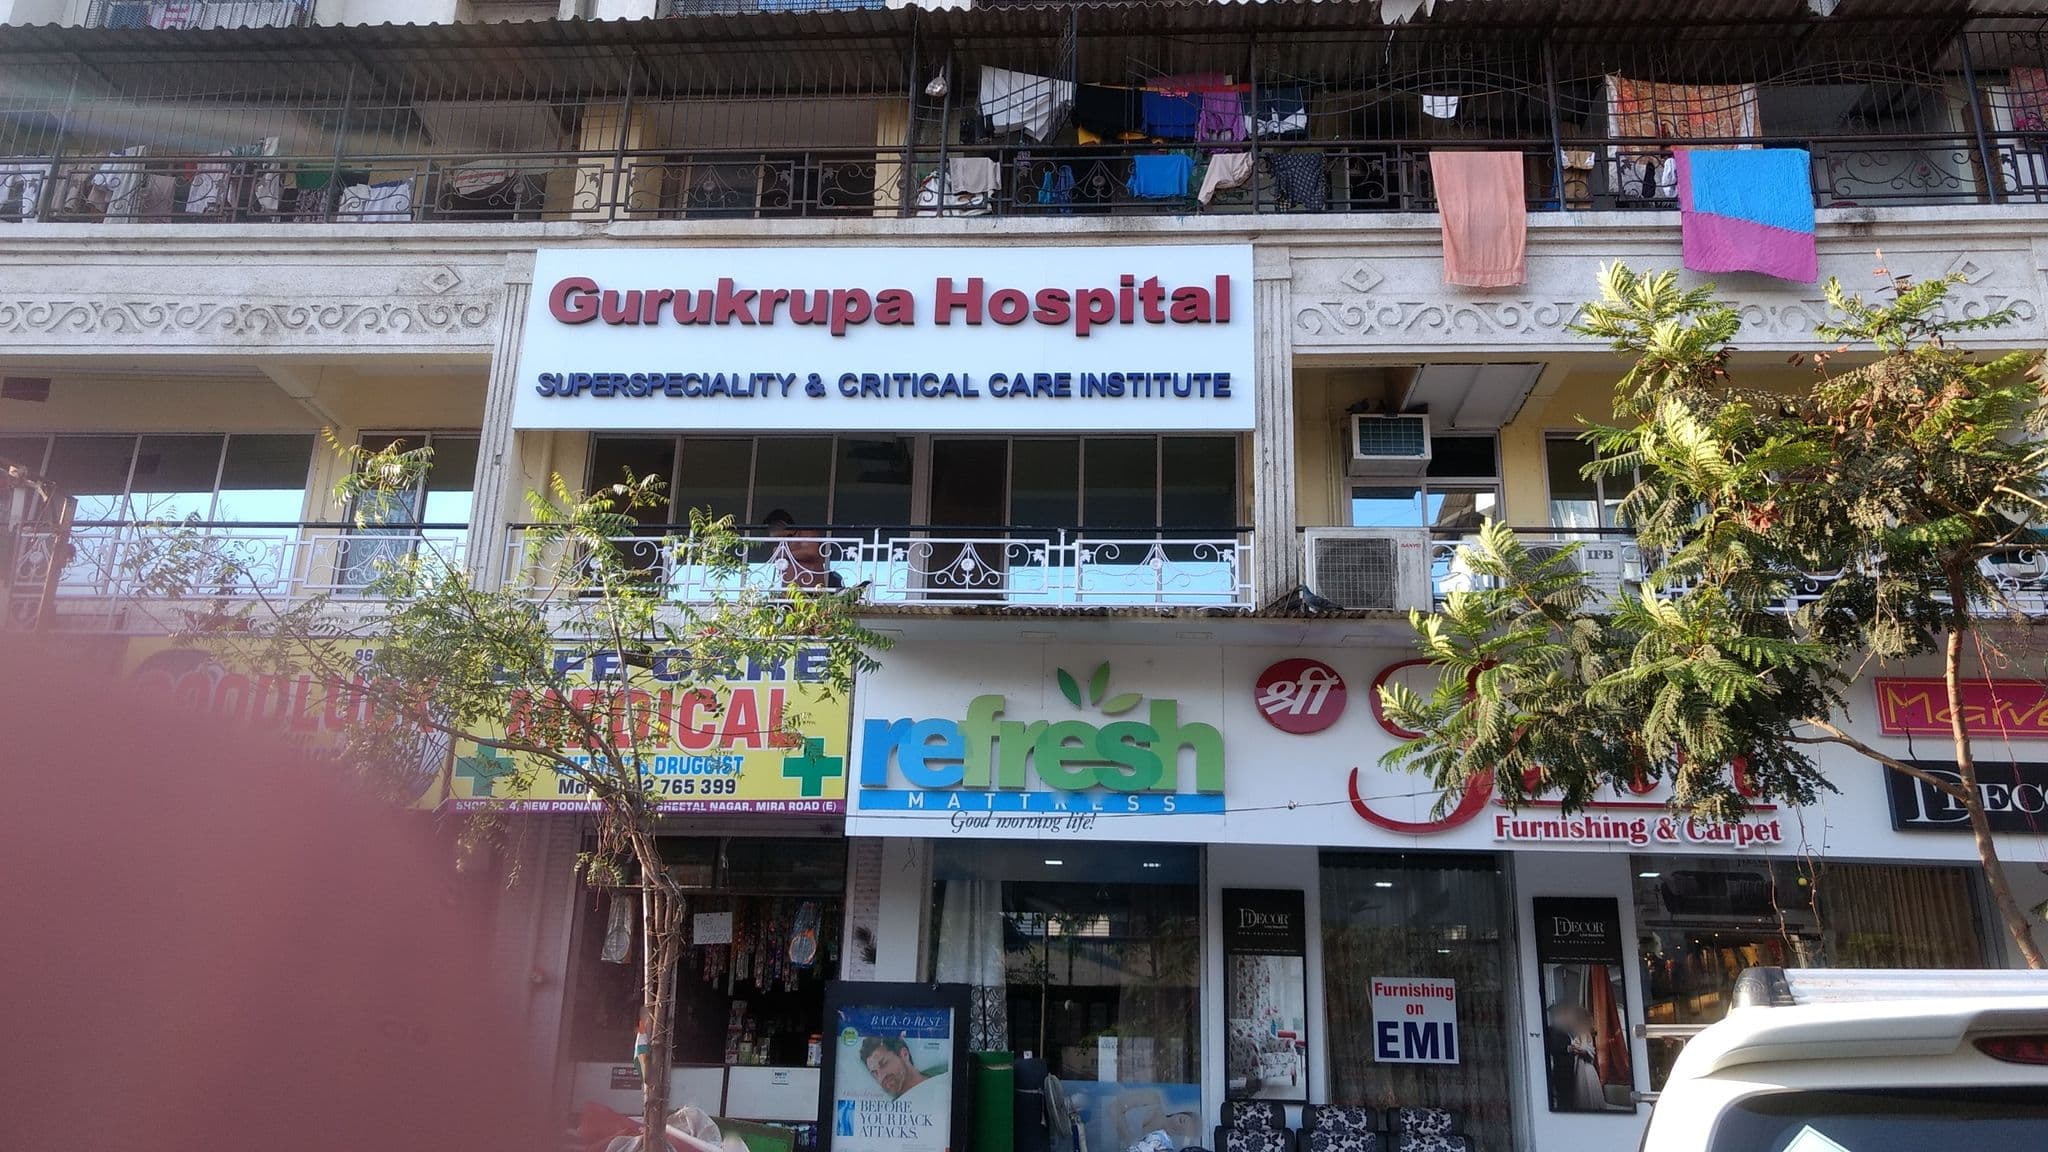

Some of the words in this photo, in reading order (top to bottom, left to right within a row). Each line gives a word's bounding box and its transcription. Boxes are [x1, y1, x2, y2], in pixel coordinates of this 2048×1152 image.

[548, 276, 914, 337] Gurukrupa
[934, 275, 1231, 336] Hospital
[536, 373, 796, 398] SUPERSPECIALITY
[806, 375, 825, 398] &
[838, 373, 979, 397] CRITICAL
[989, 373, 1073, 397] CARE
[1080, 373, 1231, 397] INSTITUTE
[1586, 549, 1614, 560] IFB
[1257, 666, 1341, 716] श्री
[861, 694, 1225, 795] refresh
[654, 756, 744, 775] DRUGGIST
[660, 778, 695, 795] 765
[700, 778, 736, 795] 399
[551, 801, 602, 812] POONAM
[709, 802, 752, 812] NAGAR,
[755, 801, 786, 812] MIRA
[788, 801, 820, 812] ROAD
[822, 801, 837, 813] (E)
[950, 810, 992, 834] Good
[995, 811, 1061, 833] morning
[1065, 811, 1097, 832] life!
[1497, 815, 1648, 845] Furnishing
[1655, 820, 1679, 841] &
[1687, 820, 1782, 848] Carpet
[1374, 982, 1454, 1001] Furnishing
[1406, 1000, 1425, 1015] on
[1377, 1020, 1455, 1060] EMI
[860, 1100, 913, 1113] BEFORE
[860, 1113, 896, 1126] YOUR
[897, 1114, 934, 1127] BACK
